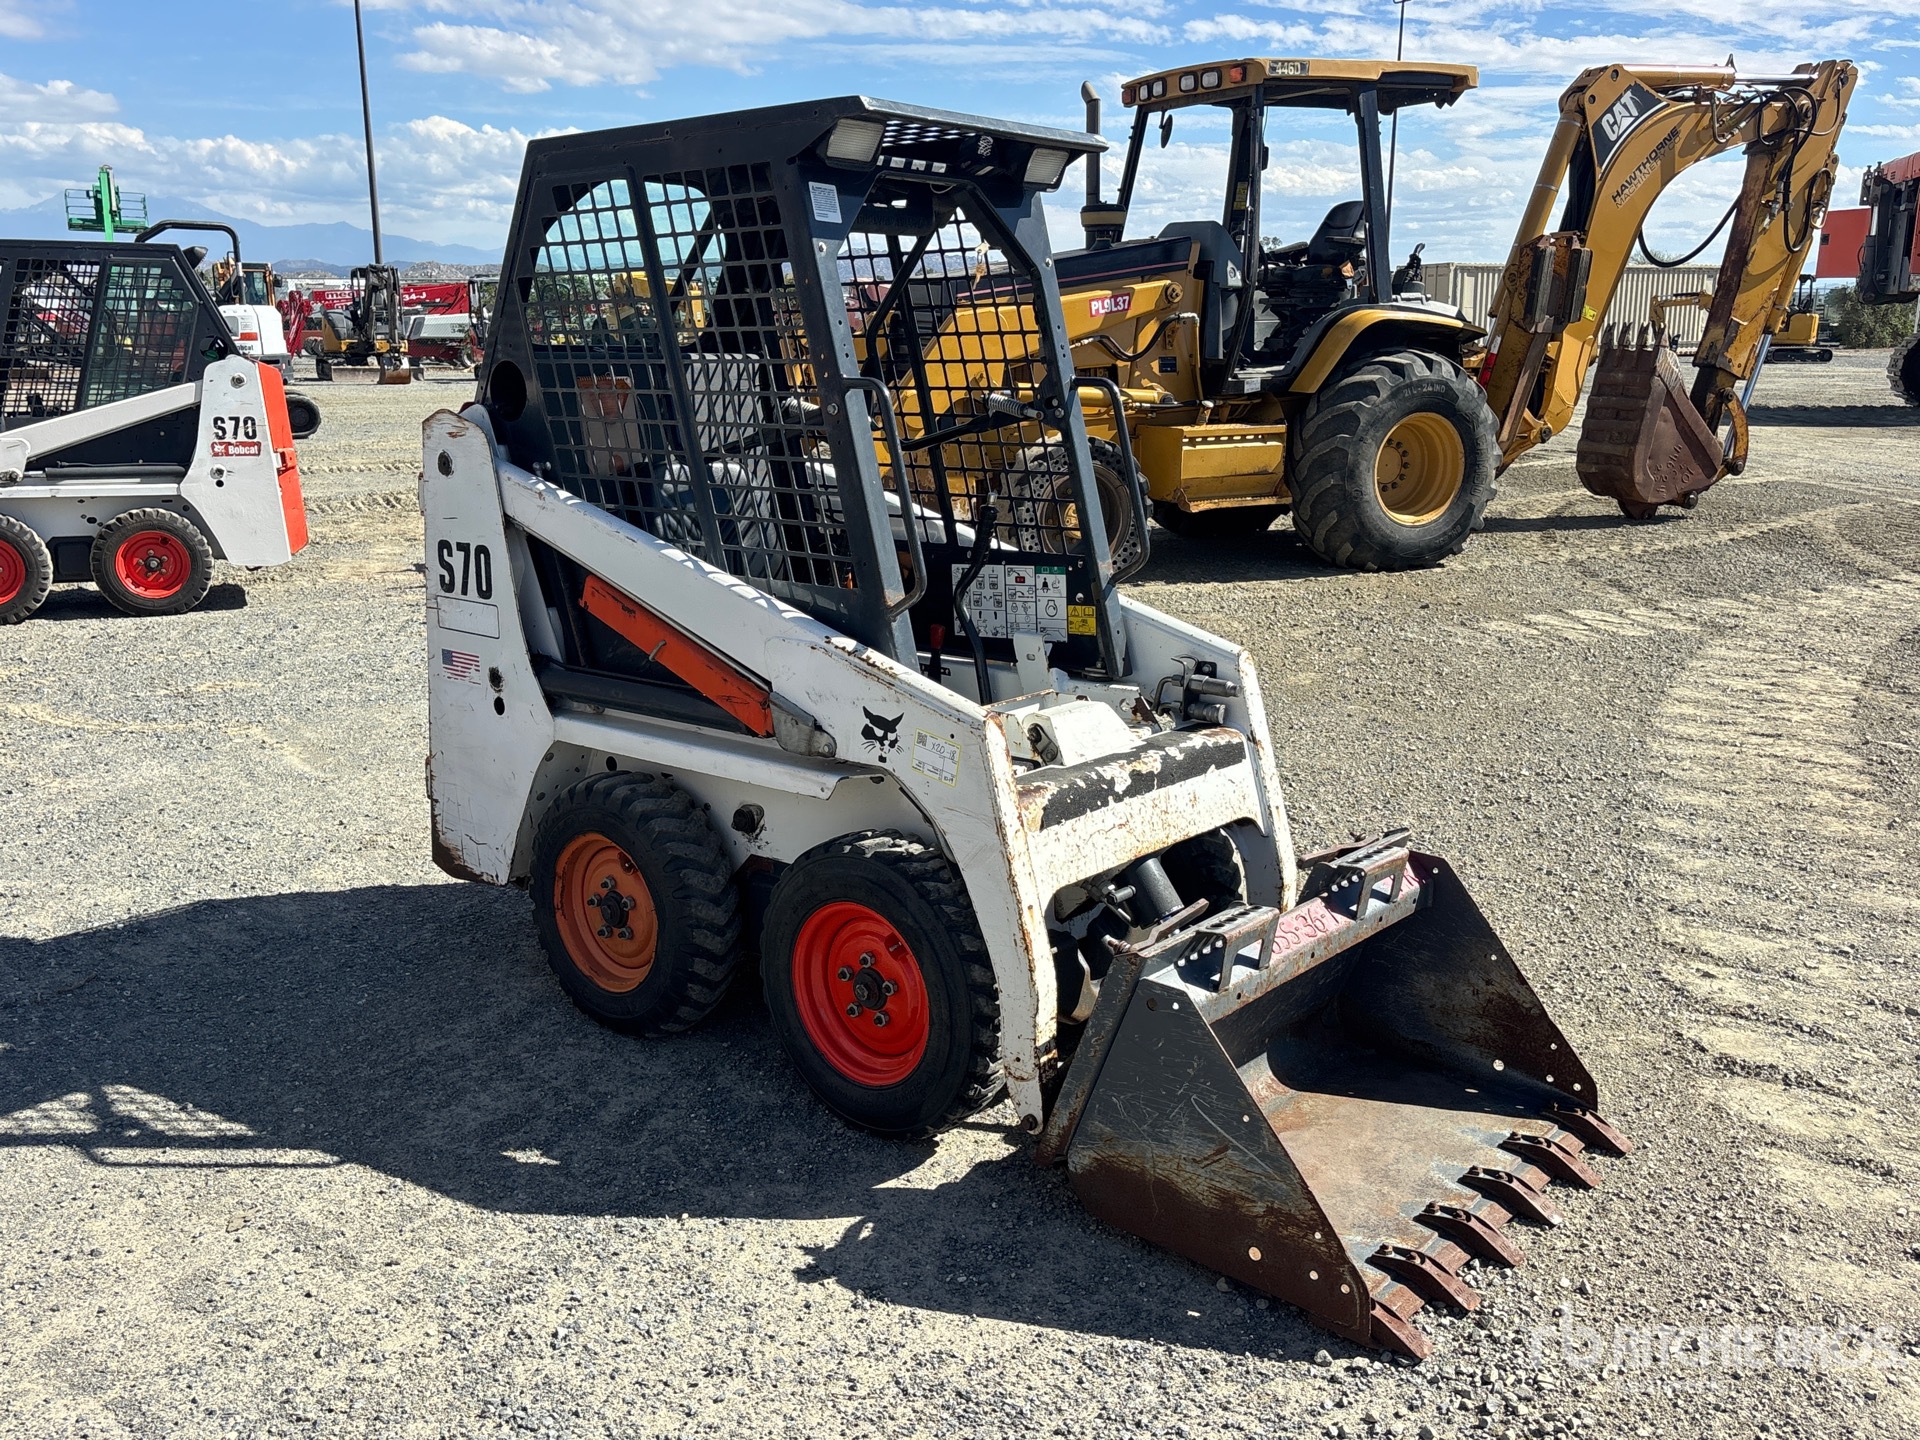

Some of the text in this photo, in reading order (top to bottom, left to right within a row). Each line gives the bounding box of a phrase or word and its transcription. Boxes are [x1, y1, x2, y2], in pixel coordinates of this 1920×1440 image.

[1275, 62, 1301, 75] 446D
[1601, 90, 1639, 142] CAT
[1612, 126, 1680, 202] HAWTHORNE
[1616, 151, 1667, 209] MACHINERY
[1091, 296, 1130, 315] PL9L37
[213, 416, 257, 440] S70
[228, 445, 258, 455] Bobcat
[437, 539, 493, 600] S70
